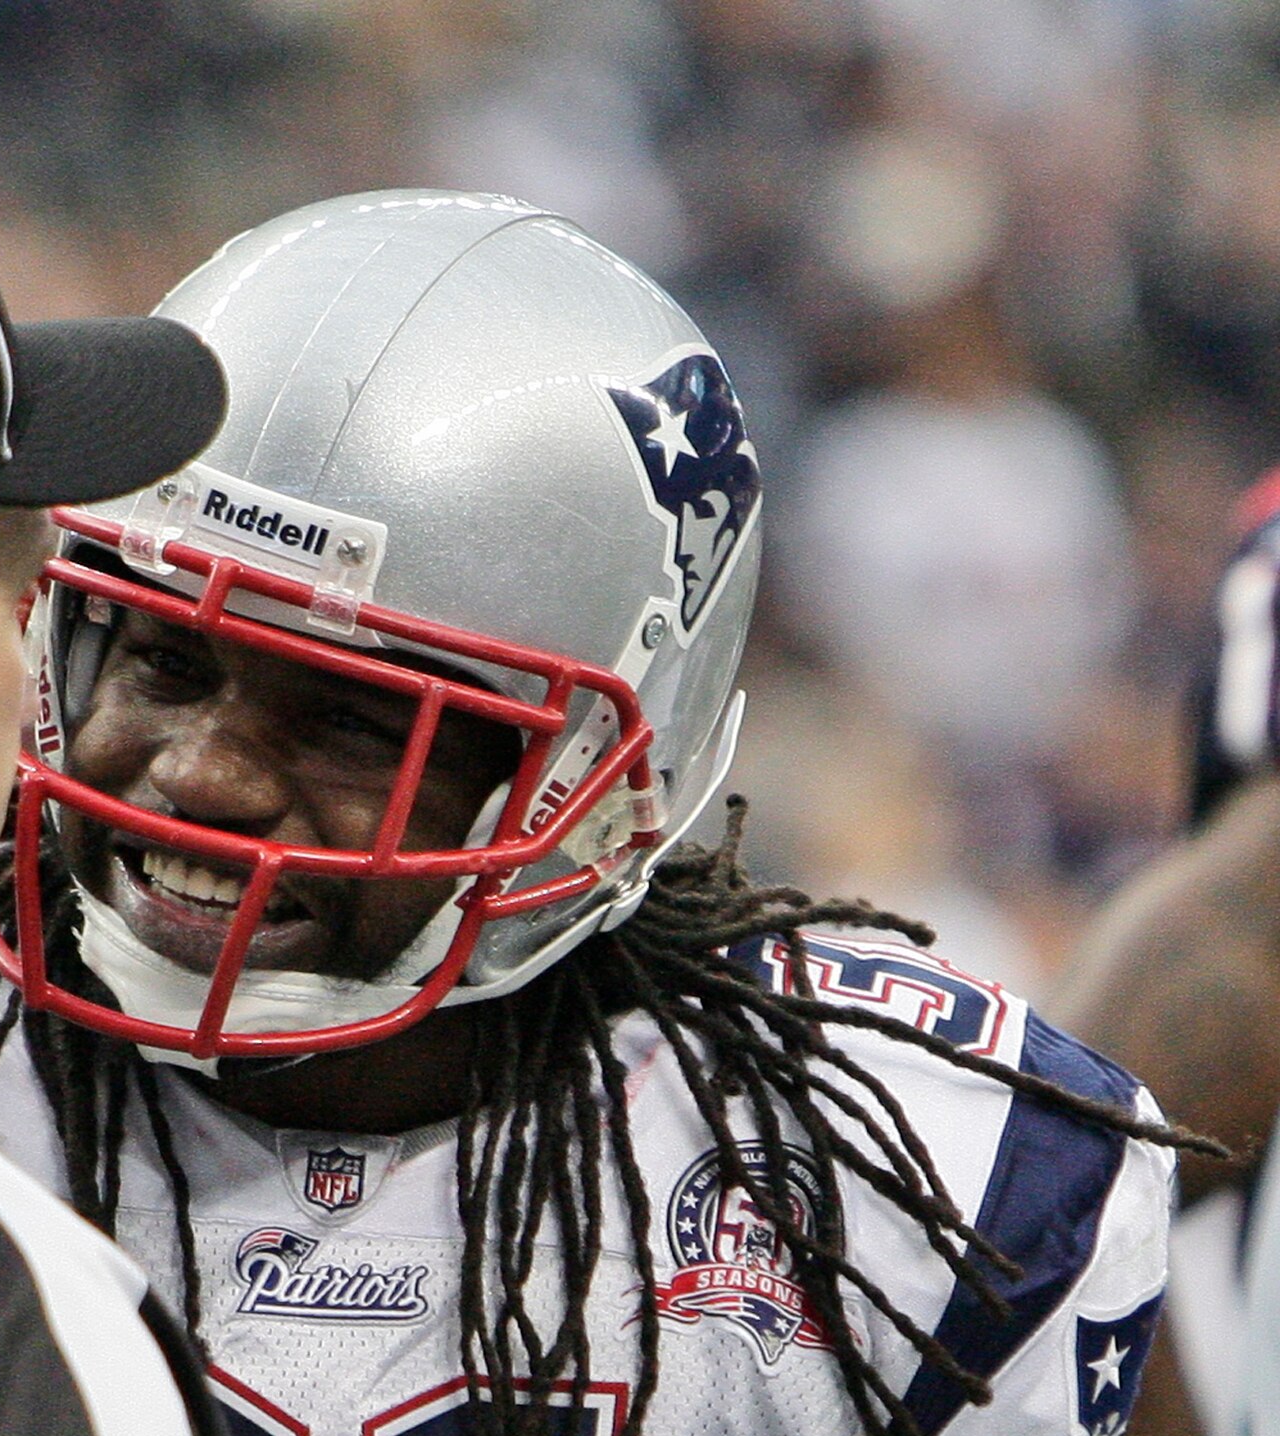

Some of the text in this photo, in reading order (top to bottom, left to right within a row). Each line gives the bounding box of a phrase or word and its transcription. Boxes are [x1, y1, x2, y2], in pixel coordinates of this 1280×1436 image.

[203, 489, 330, 557] Riddell
[309, 1171, 357, 1205] NFL
[236, 1245, 431, 1320] Patriots
